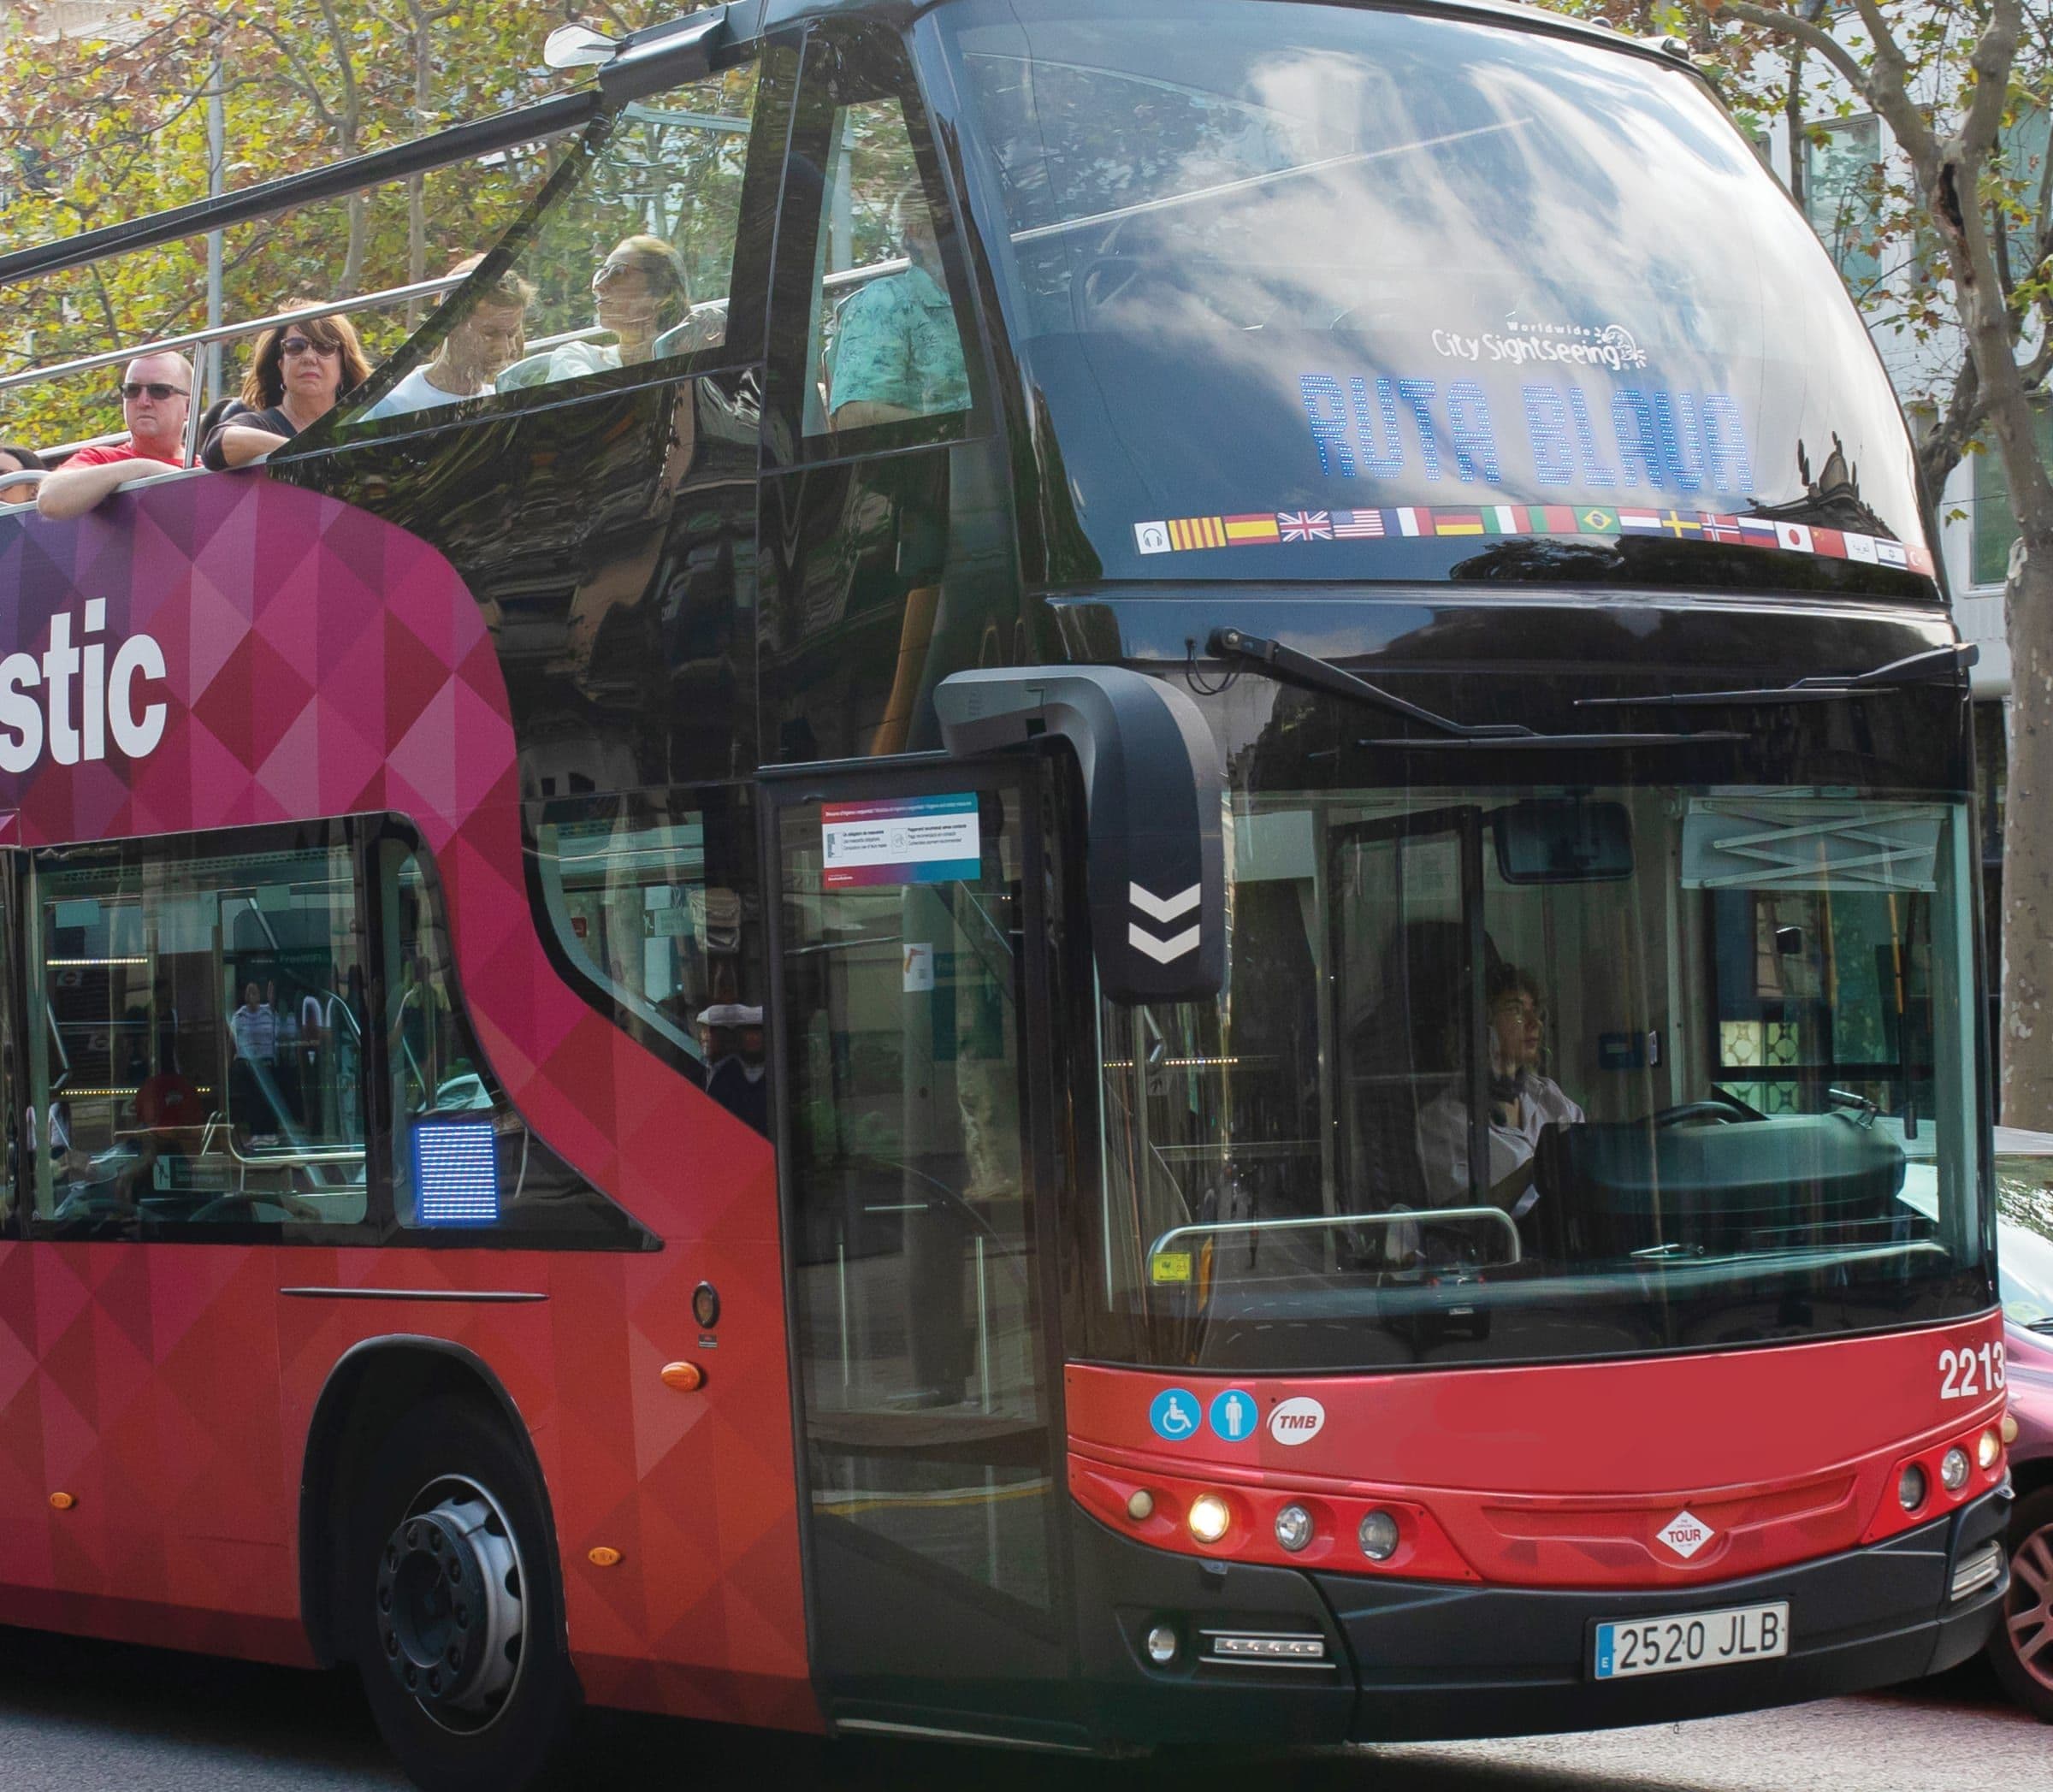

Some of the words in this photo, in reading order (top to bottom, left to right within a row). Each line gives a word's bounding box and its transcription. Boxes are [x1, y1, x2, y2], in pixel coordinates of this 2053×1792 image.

[1431, 328, 1482, 361] City
[1482, 333, 1622, 370] Sightseeing
[1507, 321, 1591, 336] Worldwide
[1299, 375, 1501, 484] RUTA
[1521, 385, 1753, 492] BLAVA
[1938, 1340, 2005, 1399] 2213
[1280, 1415, 1317, 1429] TMB
[1668, 1529, 1701, 1543] TOUR
[1601, 1656, 1609, 1669] E
[1619, 1621, 1705, 1670] 2520
[1719, 1612, 1779, 1656] JLB
